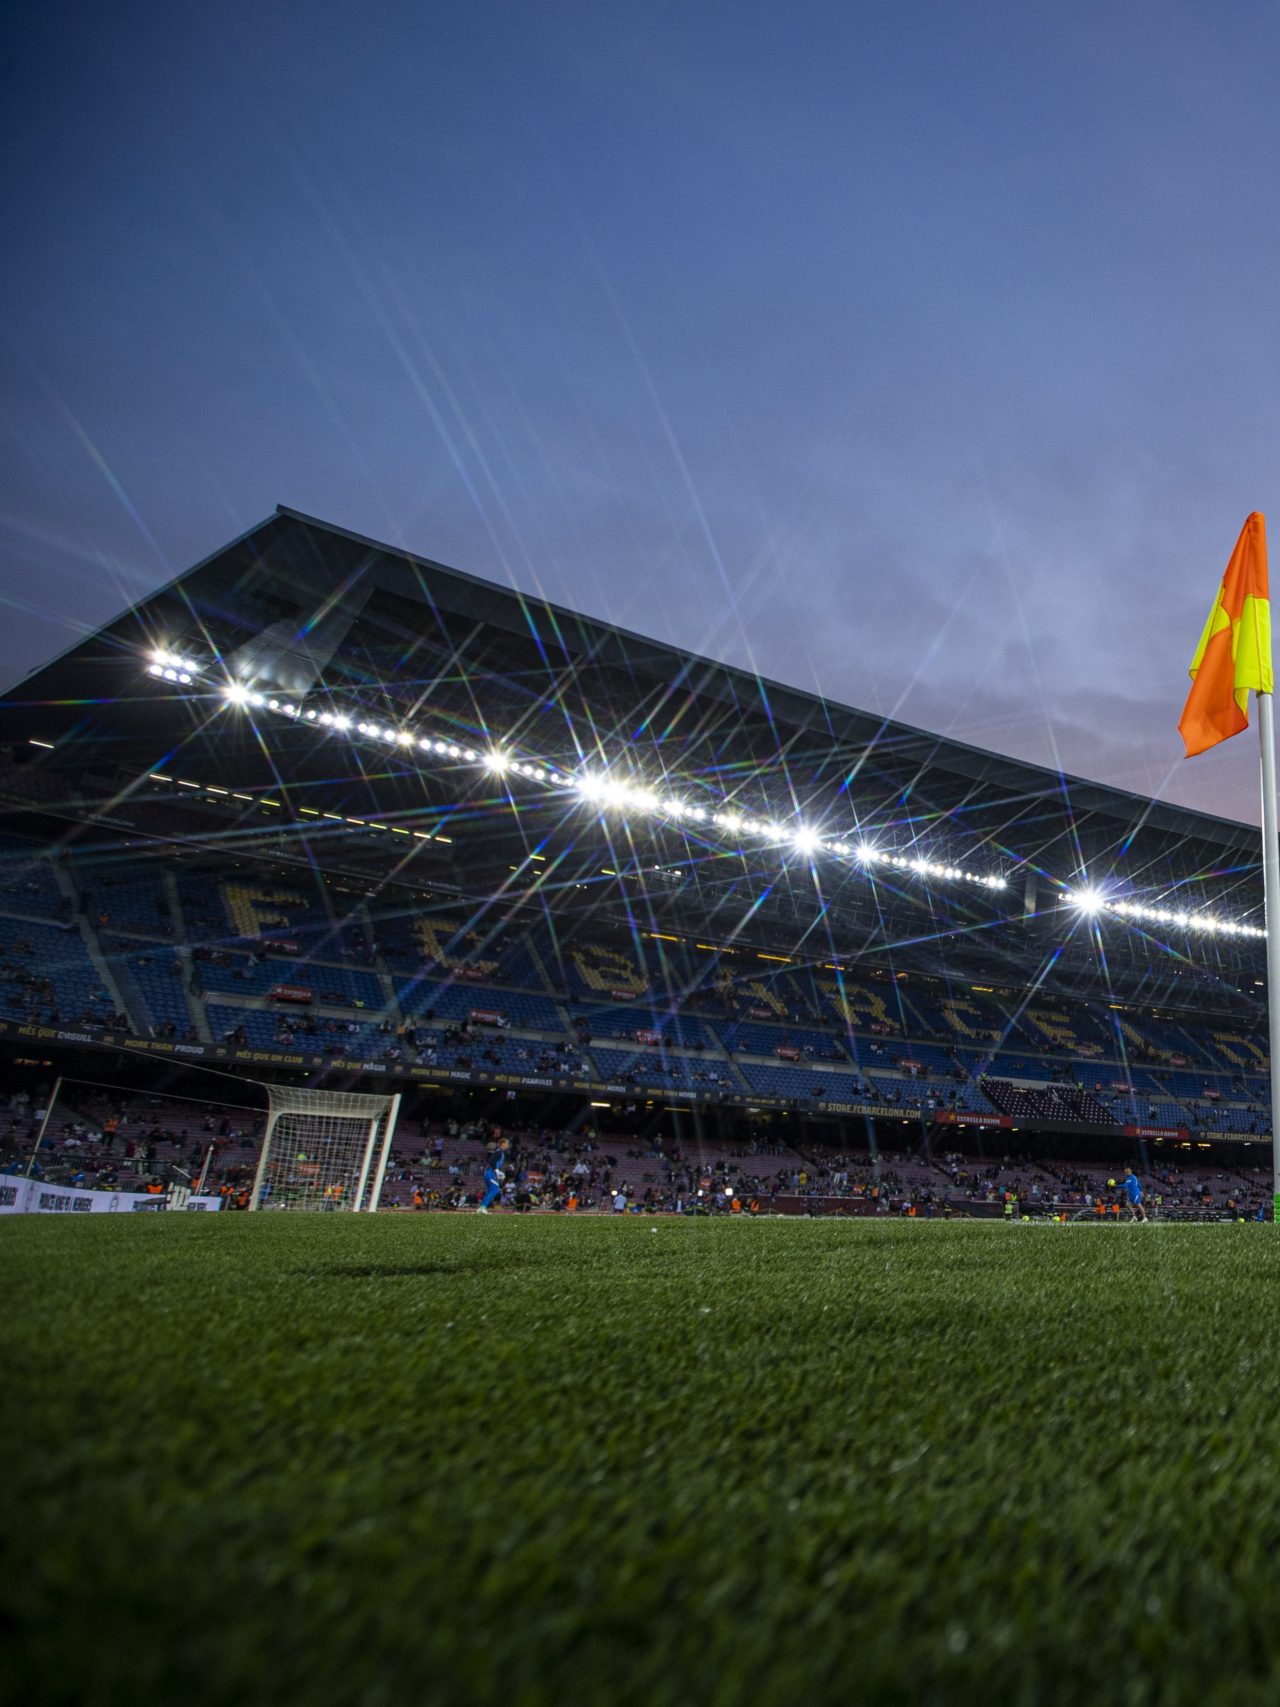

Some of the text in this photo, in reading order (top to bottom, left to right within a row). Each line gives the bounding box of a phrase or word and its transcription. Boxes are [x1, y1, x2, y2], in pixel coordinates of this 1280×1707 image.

[124, 1039, 205, 1055] MORE THAN PROUD
[284, 1056, 304, 1064] CLUB
[450, 1071, 472, 1080] MAGIC
[827, 1102, 921, 1119] STORE.FCBARCELONA.COM
[957, 1115, 1001, 1125] ESTRELLA DAMM
[1141, 1129, 1164, 1137] ESTRELLA
